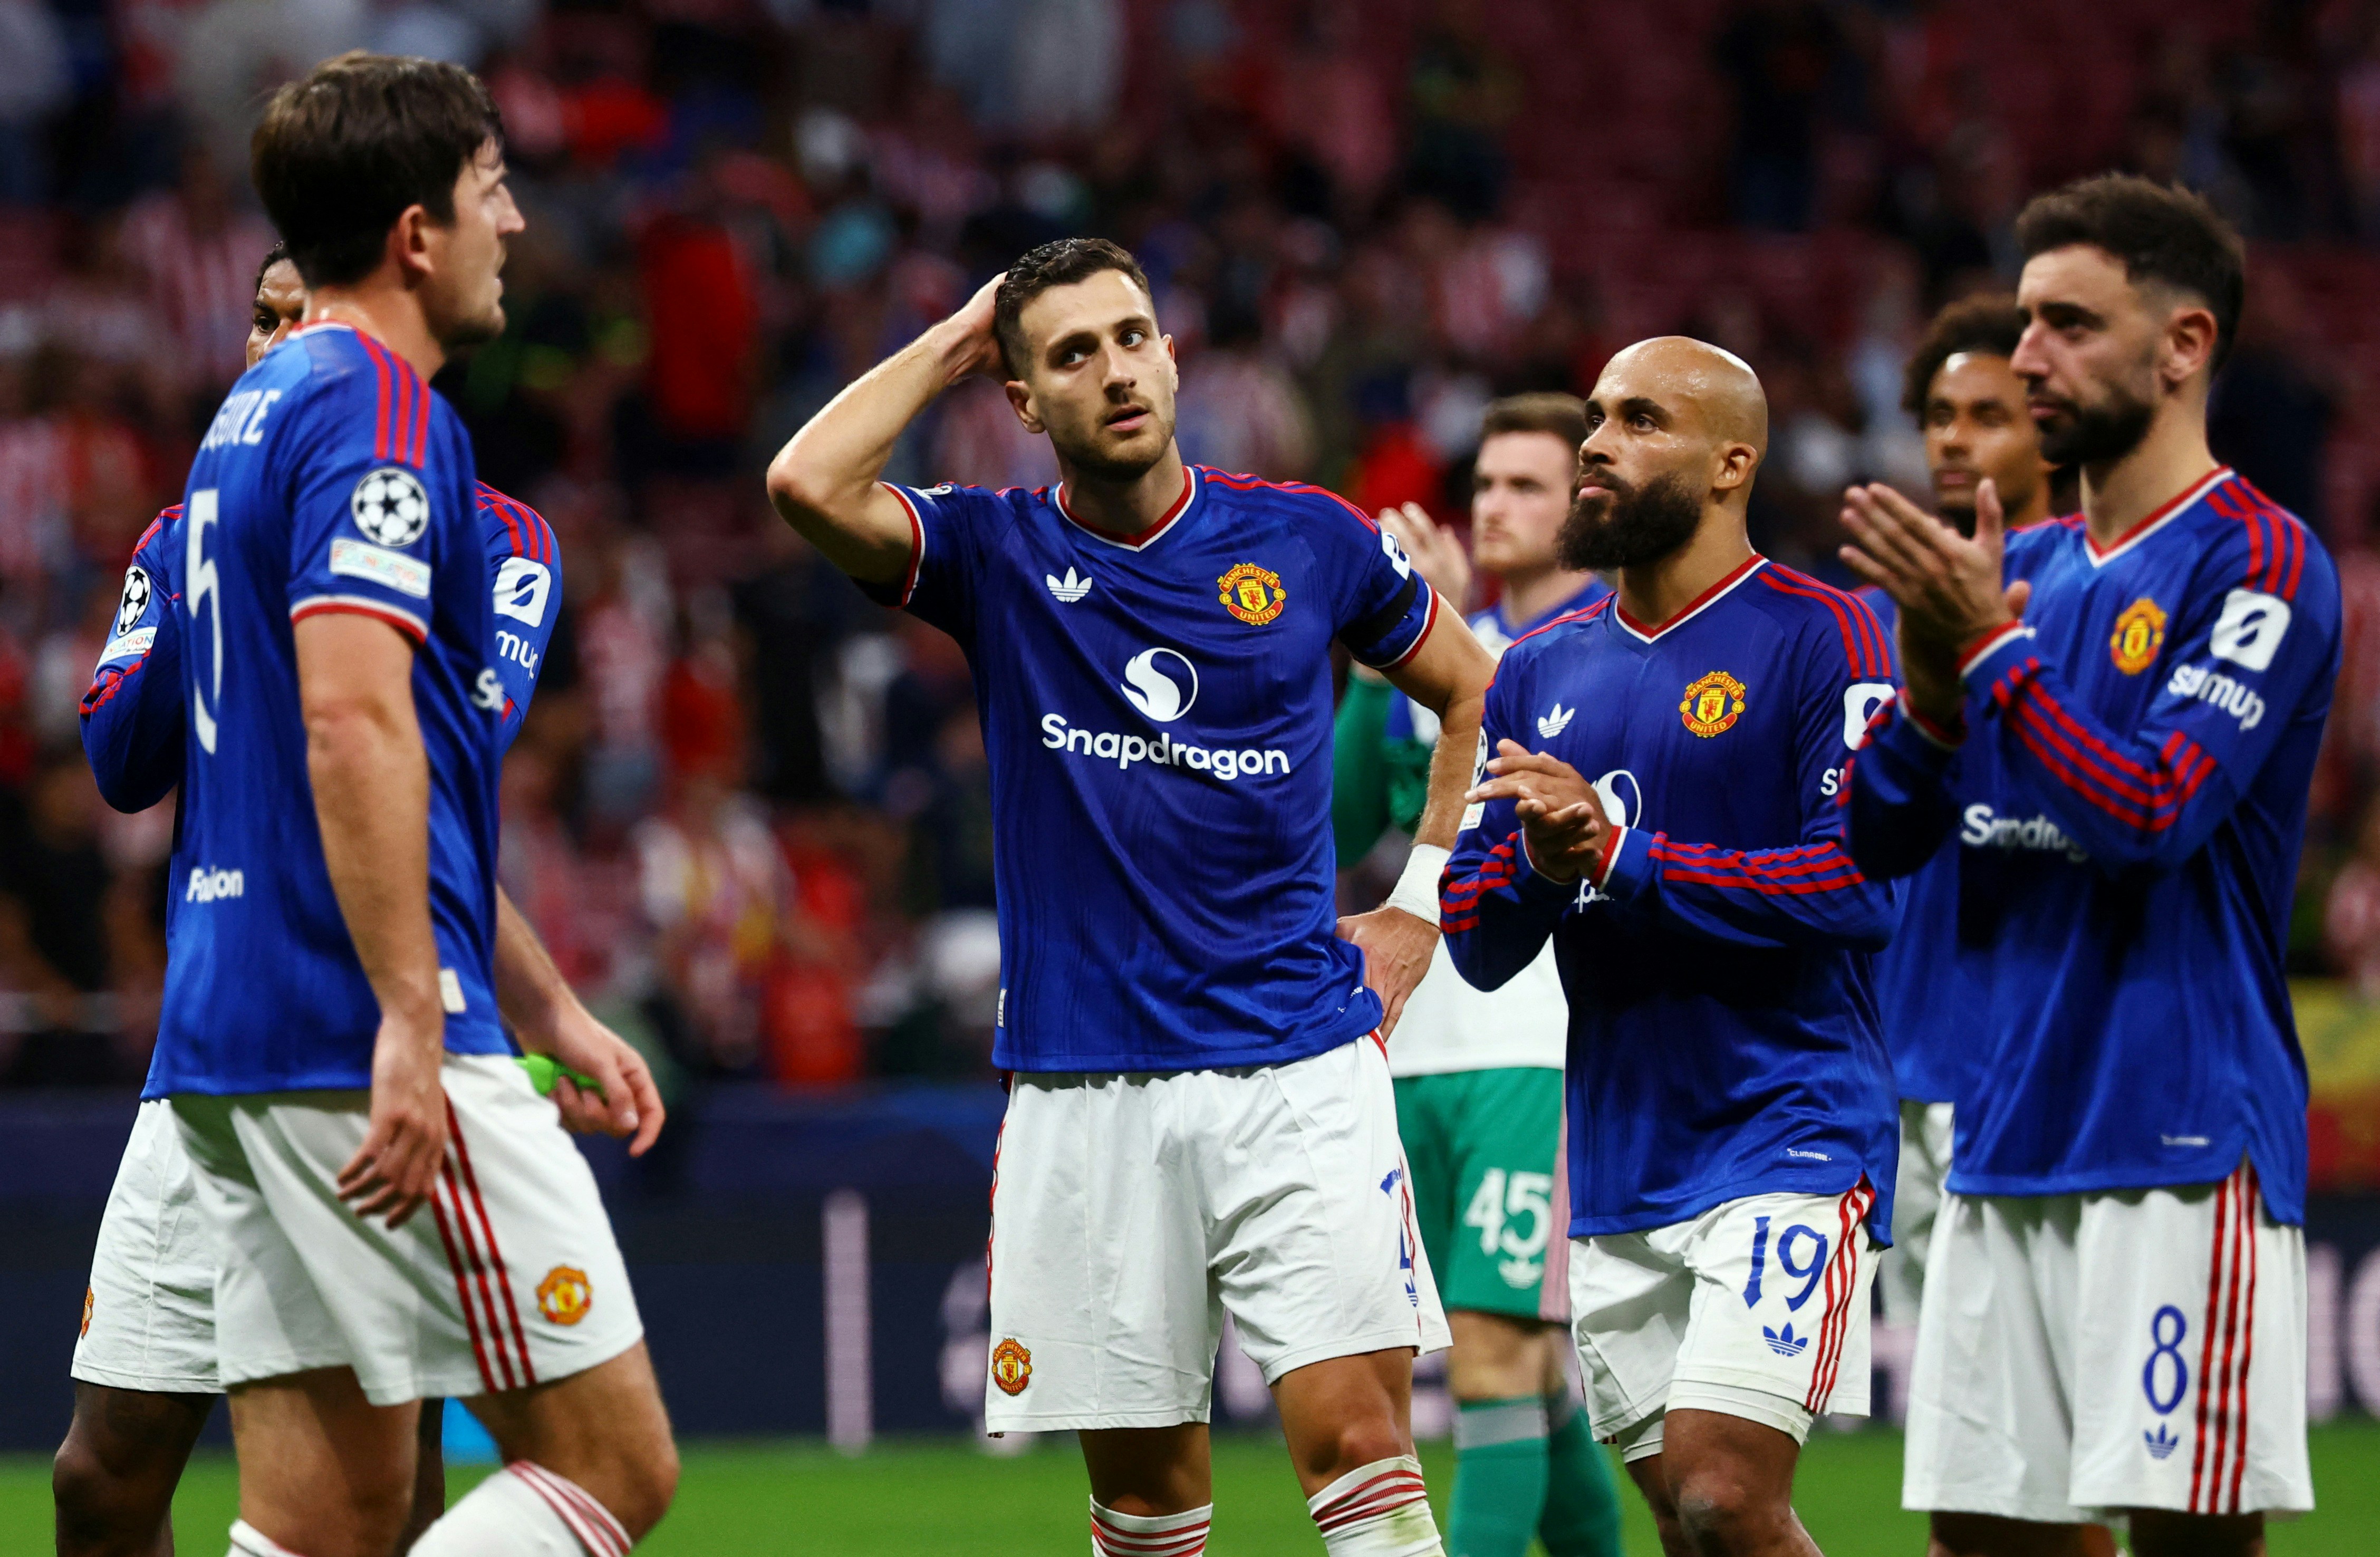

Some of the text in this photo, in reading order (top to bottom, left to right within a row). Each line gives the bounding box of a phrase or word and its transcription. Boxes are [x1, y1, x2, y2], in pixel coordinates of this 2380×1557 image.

[1222, 567, 1276, 589] MANCHESTER
[186, 489, 223, 755] 5
[1239, 608, 1277, 621] UNITED
[1688, 675, 1740, 698] MANCHESTER
[1689, 721, 1727, 733] UNITED
[1041, 713, 1291, 781] Snapdragon
[1463, 1166, 1553, 1259] 45
[1742, 1215, 1828, 1313] 19
[994, 1343, 1027, 1361] MANCHESTER
[2142, 1303, 2188, 1415] 8
[1000, 1381, 1023, 1391] UNITED
